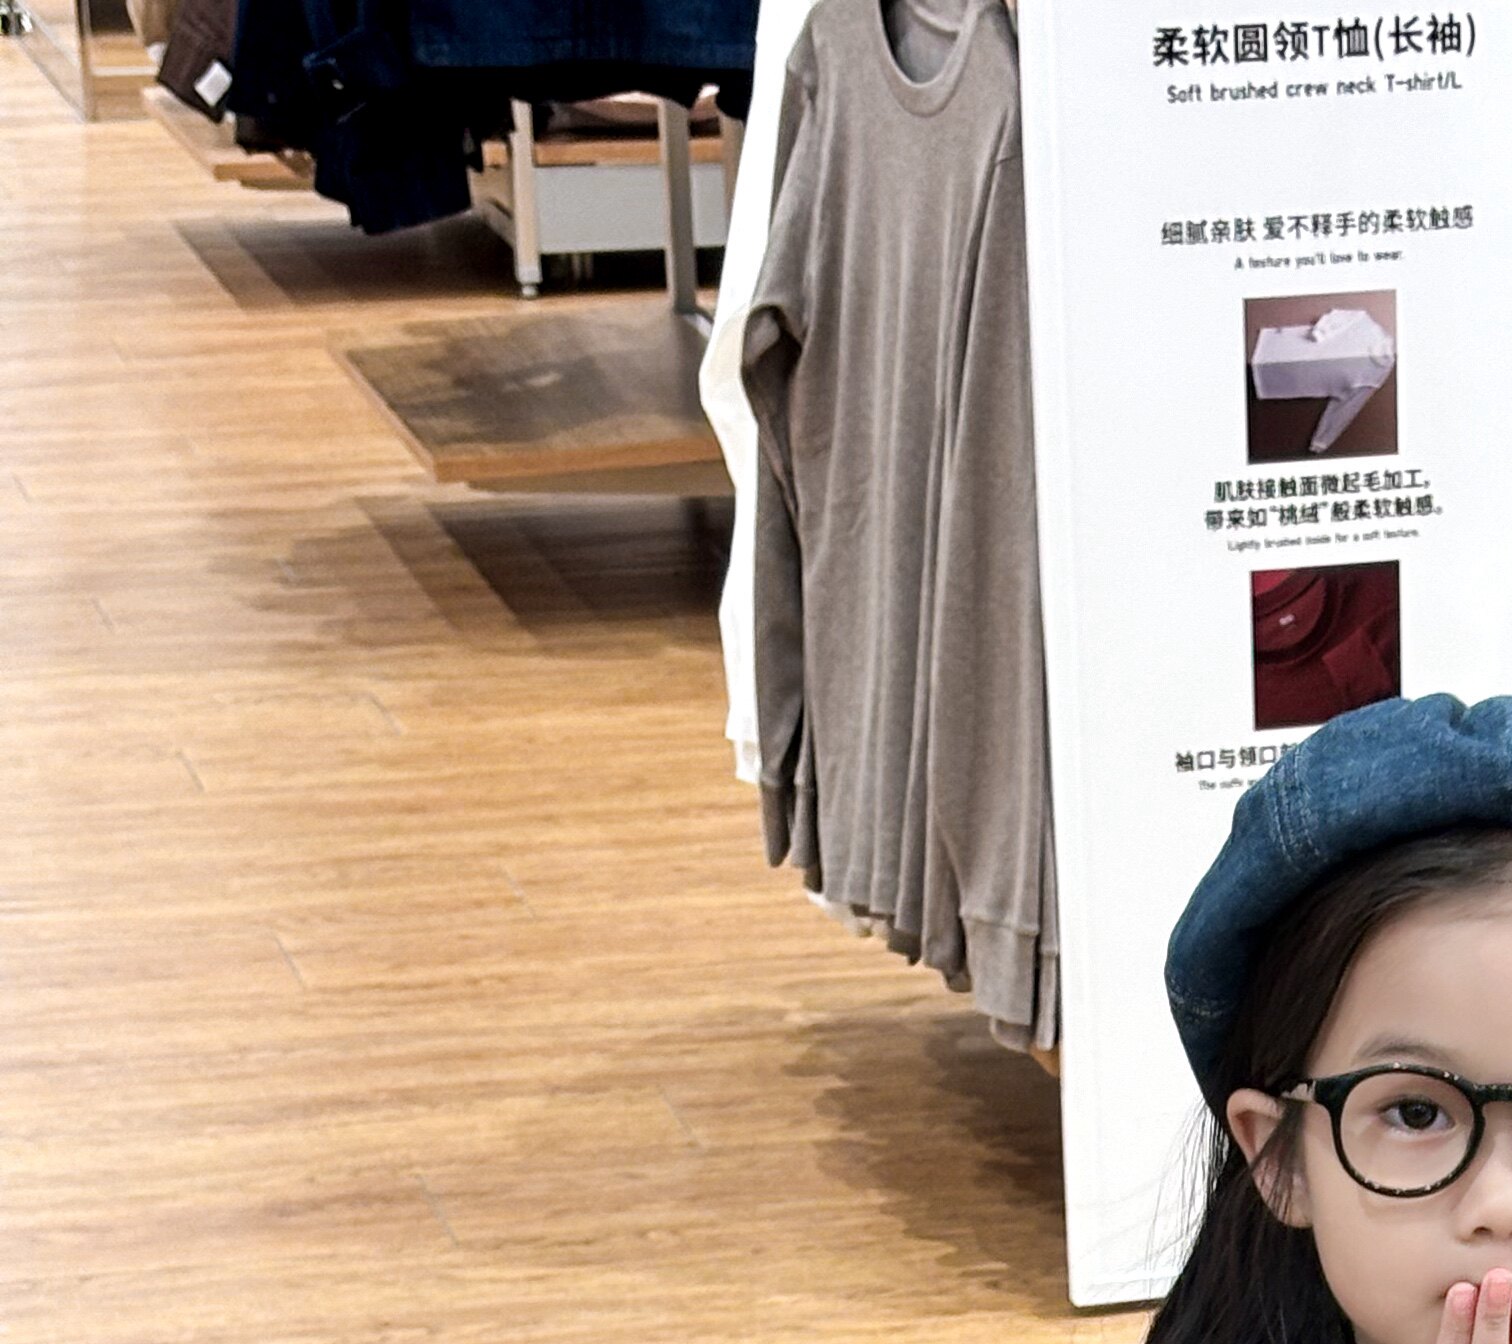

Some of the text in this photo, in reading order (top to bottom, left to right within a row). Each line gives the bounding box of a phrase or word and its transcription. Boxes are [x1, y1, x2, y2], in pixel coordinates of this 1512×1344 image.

[1153, 13, 1475, 67] 柔软圆领T恤(长袖)
[1167, 71, 1462, 104] Soft brushed crew neck T-shirt/L
[1161, 205, 1474, 245] 细腻亲肤 爱不释手的柔软触感
[1175, 743, 1297, 772] 袖口与领口
